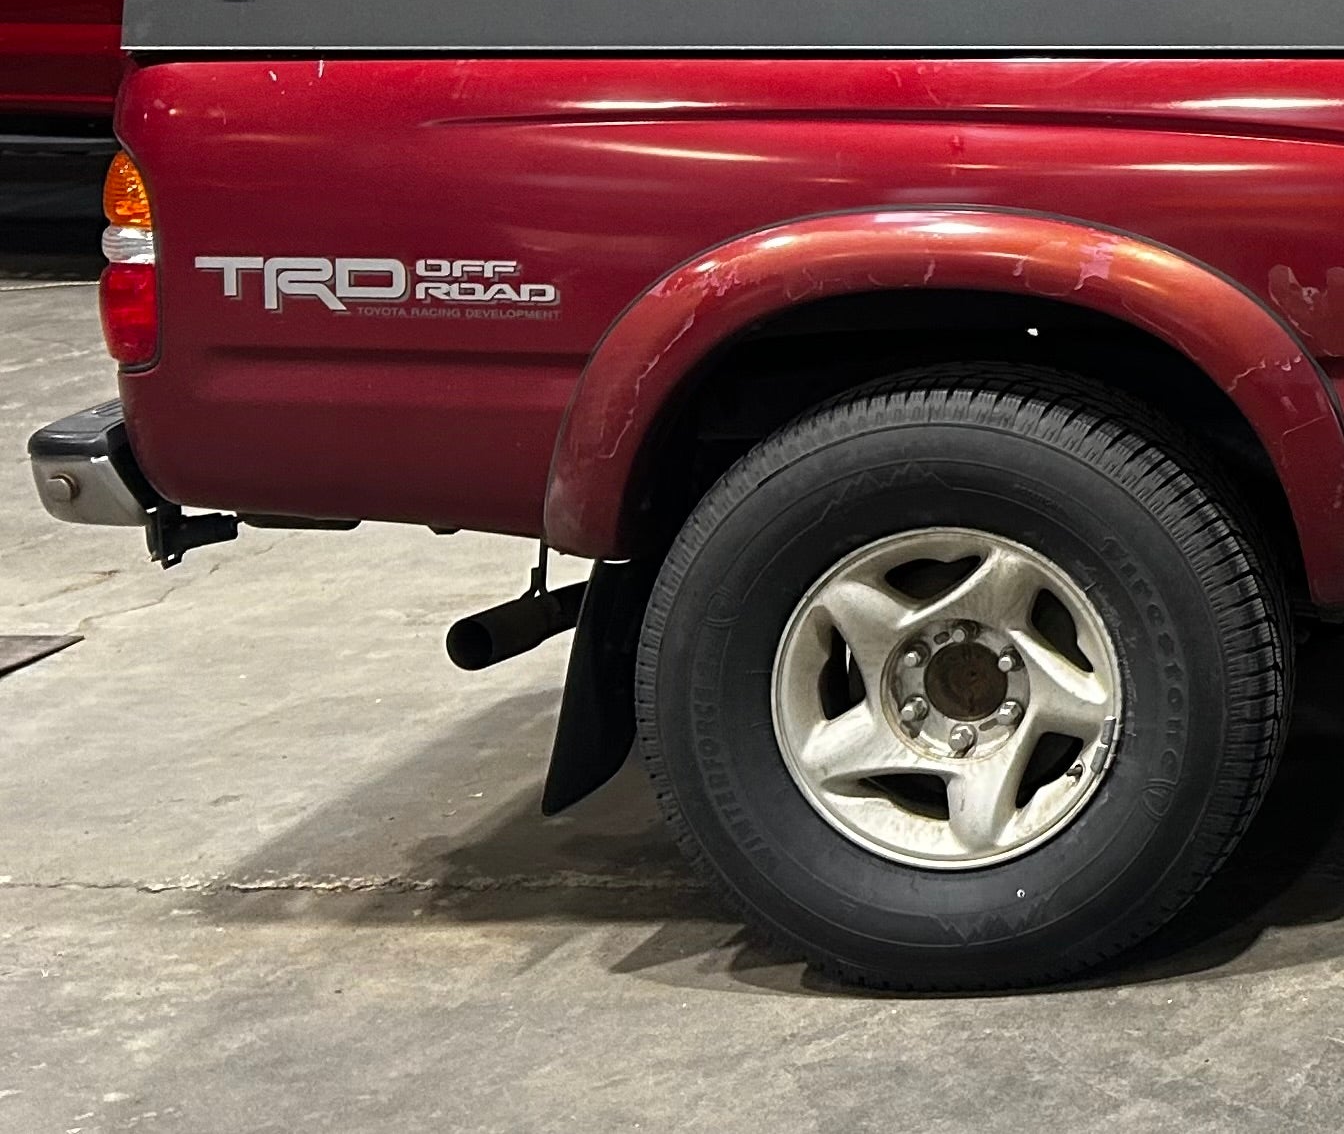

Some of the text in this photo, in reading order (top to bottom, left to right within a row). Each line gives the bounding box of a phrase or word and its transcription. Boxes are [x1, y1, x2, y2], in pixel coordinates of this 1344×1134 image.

[415, 259, 519, 279] OFF
[195, 256, 408, 312] TRD
[415, 281, 557, 304] ROAD
[358, 306, 562, 320] TOYOTA RACING DEVELOPMENT
